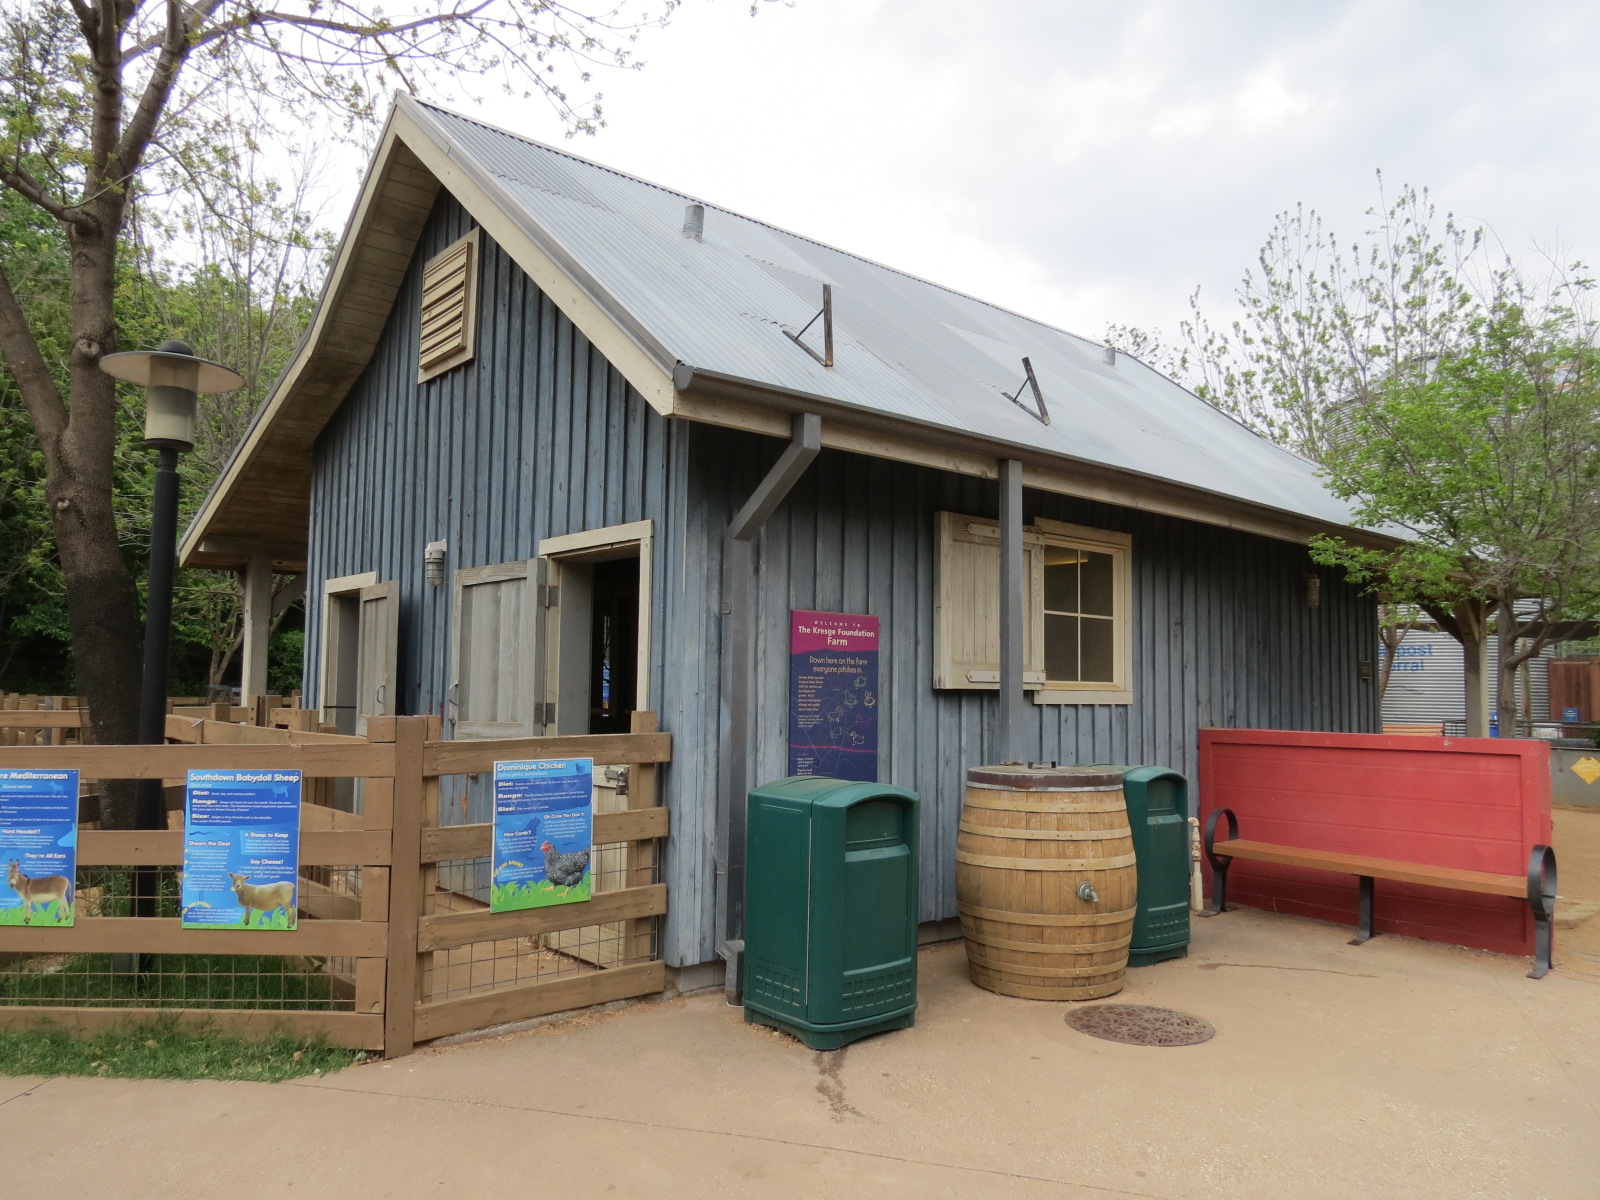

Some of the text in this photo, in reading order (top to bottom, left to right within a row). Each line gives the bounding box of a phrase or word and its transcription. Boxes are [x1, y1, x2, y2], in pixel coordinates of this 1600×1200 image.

[813, 627, 836, 636] Kresge
[838, 629, 874, 637] Foundation
[827, 637, 847, 645] Farm
[809, 656, 825, 664] Down
[855, 657, 867, 665] farm
[813, 666, 837, 674] everyone
[838, 666, 856, 674] pitches
[498, 764, 536, 772] Dominique
[10, 772, 68, 780] Mediterranean
[236, 774, 272, 783] Babydoll
[274, 774, 300, 783] Sheep
